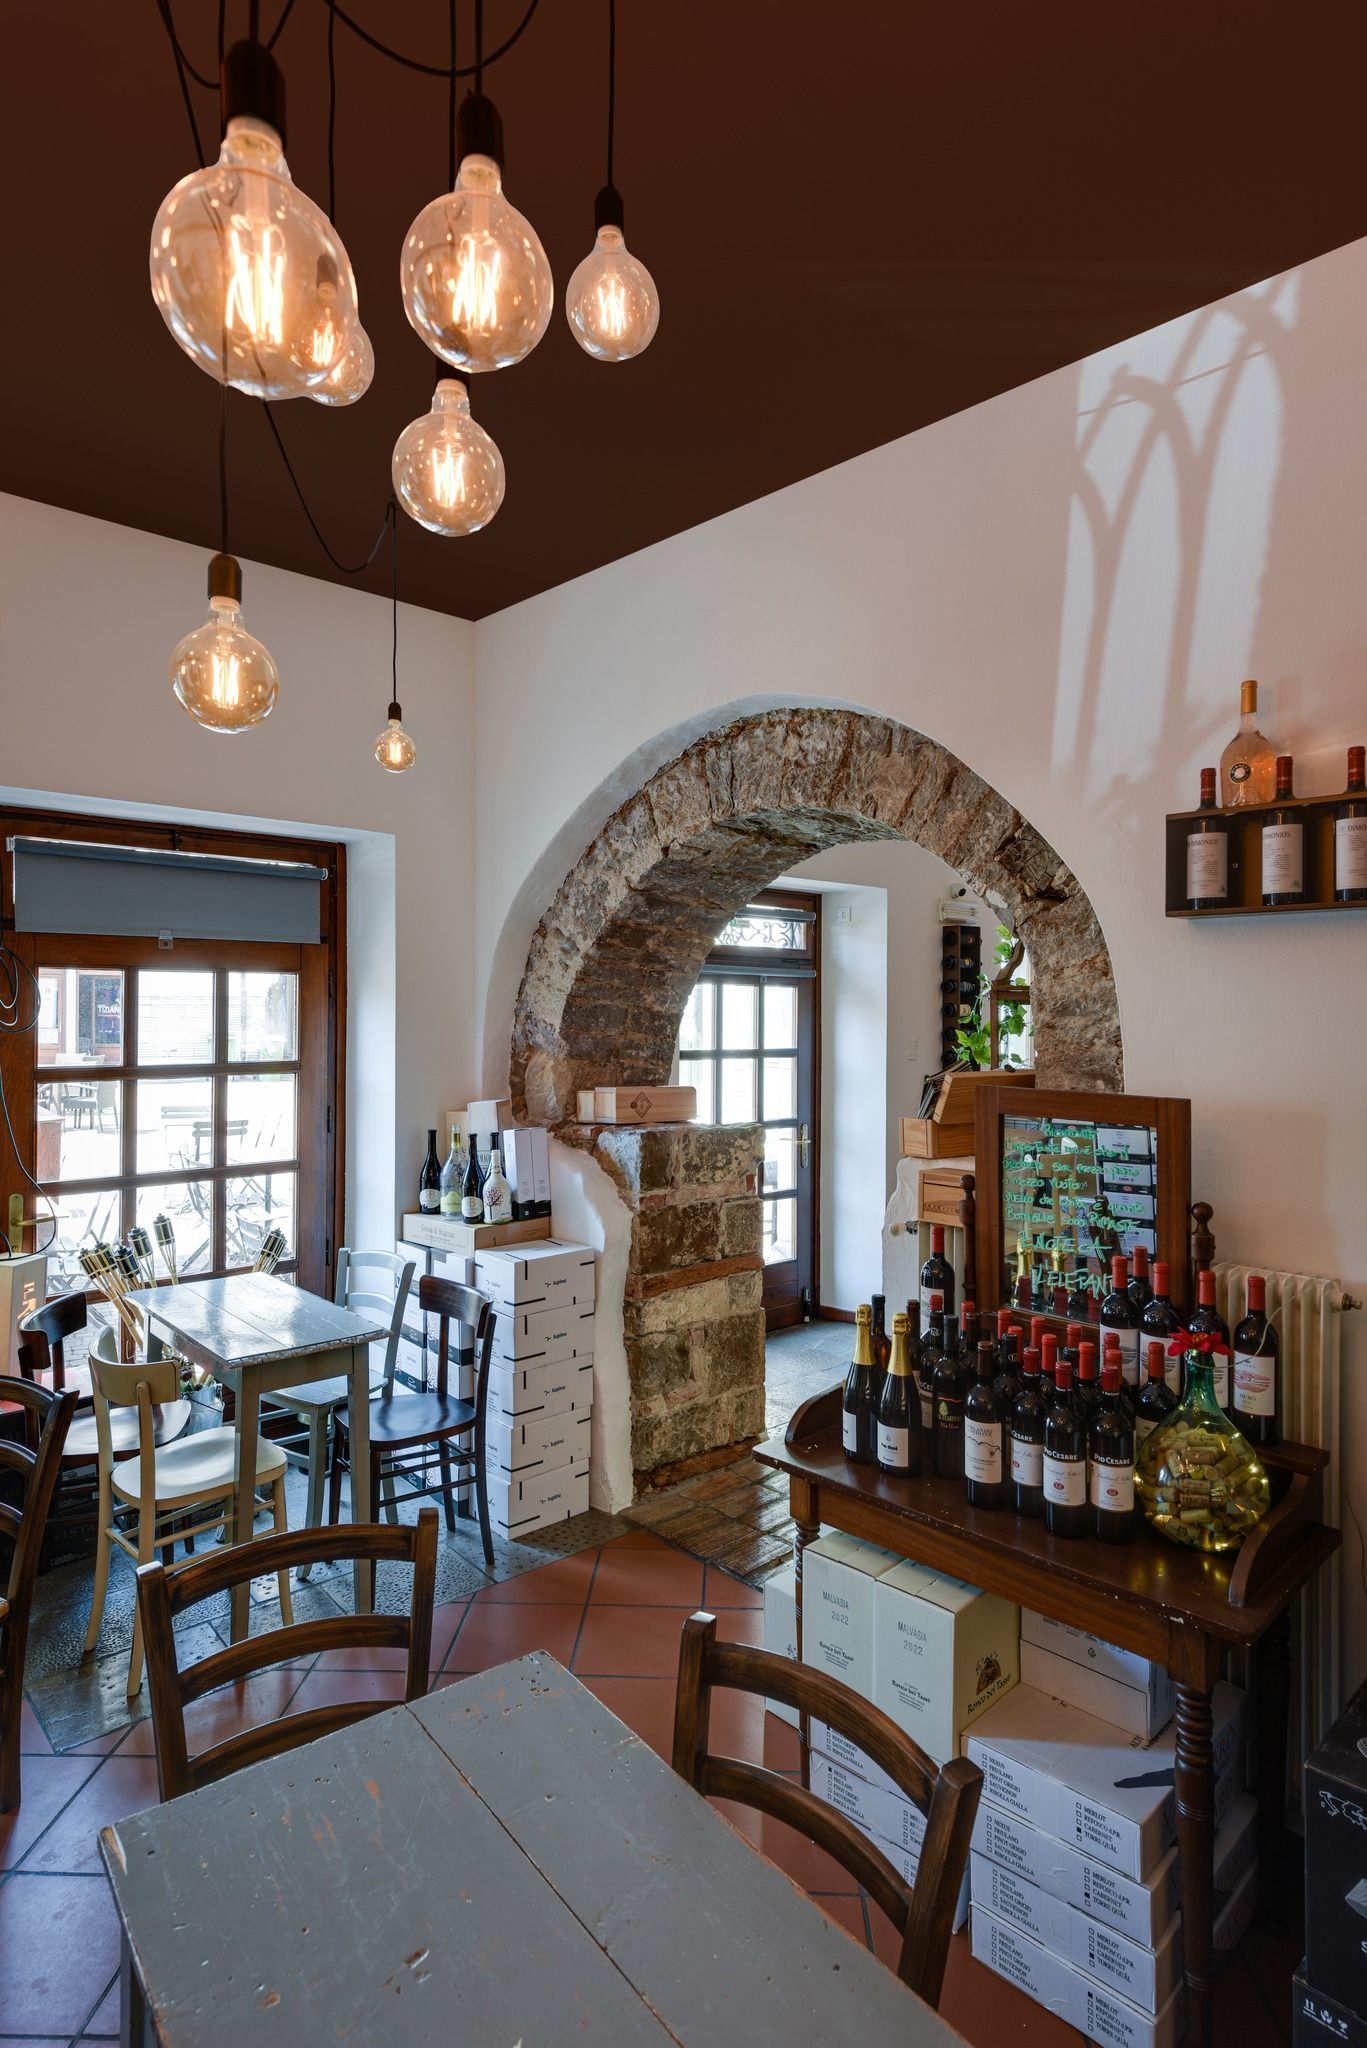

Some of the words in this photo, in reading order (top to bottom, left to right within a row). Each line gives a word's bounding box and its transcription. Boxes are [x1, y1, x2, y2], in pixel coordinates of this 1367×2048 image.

[1347, 824, 1367, 833] DIMO
[1032, 1259, 1113, 1301] L'ELEFANT
[1052, 1450, 1078, 1461] CESARE
[1094, 1453, 1105, 1463] PIO
[1105, 1456, 1131, 1465] CESARE
[822, 1590, 849, 1611] MALVASIA
[831, 1611, 849, 1626] 2022
[897, 1621, 928, 1643] MALVASIA
[903, 1640, 924, 1657] 2022
[989, 1757, 1005, 1769] NEXUS
[989, 1765, 1013, 1781] FRIULANO
[989, 1772, 1004, 1785] PINOT
[1003, 1779, 1021, 1793] GRIGIO
[989, 1780, 1018, 1799] SAUVIGNON
[989, 1788, 1010, 1804] RIBOLLA
[1009, 1798, 1028, 1813] GIALLA
[1083, 1806, 1107, 1822] MERLOT
[994, 1819, 1011, 1833] NEXUS
[994, 1827, 1019, 1845] FRIULANO
[1083, 1822, 1113, 1843] CABERNET
[994, 1835, 1009, 1848] PINOT
[1008, 1843, 1027, 1857] GRIGIO
[994, 1842, 1023, 1861] SAUVIGNON
[994, 1850, 1016, 1867] RIBOLLA
[1015, 1861, 1035, 1877] GIALLA
[999, 1873, 1016, 1887] NEXUS
[1092, 1871, 1116, 1888] MERLOT
[999, 1881, 1025, 1900] FRIULANO
[1092, 1888, 1122, 1909] CABERNET
[999, 1889, 1015, 1903] PINOT
[1014, 1897, 1032, 1913] GRIGIO
[999, 1897, 1029, 1918] SAUVIGNON
[999, 1905, 1021, 1921] RIBOLLA
[1020, 1917, 1040, 1934] GIALLA
[998, 1930, 1015, 1946] NEXUS
[1096, 1932, 1119, 1950] MERLOT
[998, 1939, 1024, 1960] FRIULANO
[998, 1946, 1014, 1961] PINOT
[1013, 1956, 1031, 1973] GRIGIO
[998, 1954, 1027, 1978] SAUVIGNON
[1096, 1949, 1126, 1971] CABERNET
[998, 1962, 1020, 1981] RIBOLLA
[1019, 1976, 1039, 1994] GIALLA
[1095, 1996, 1118, 2016] MERLOT
[1095, 2013, 1125, 2037] CABERNET
